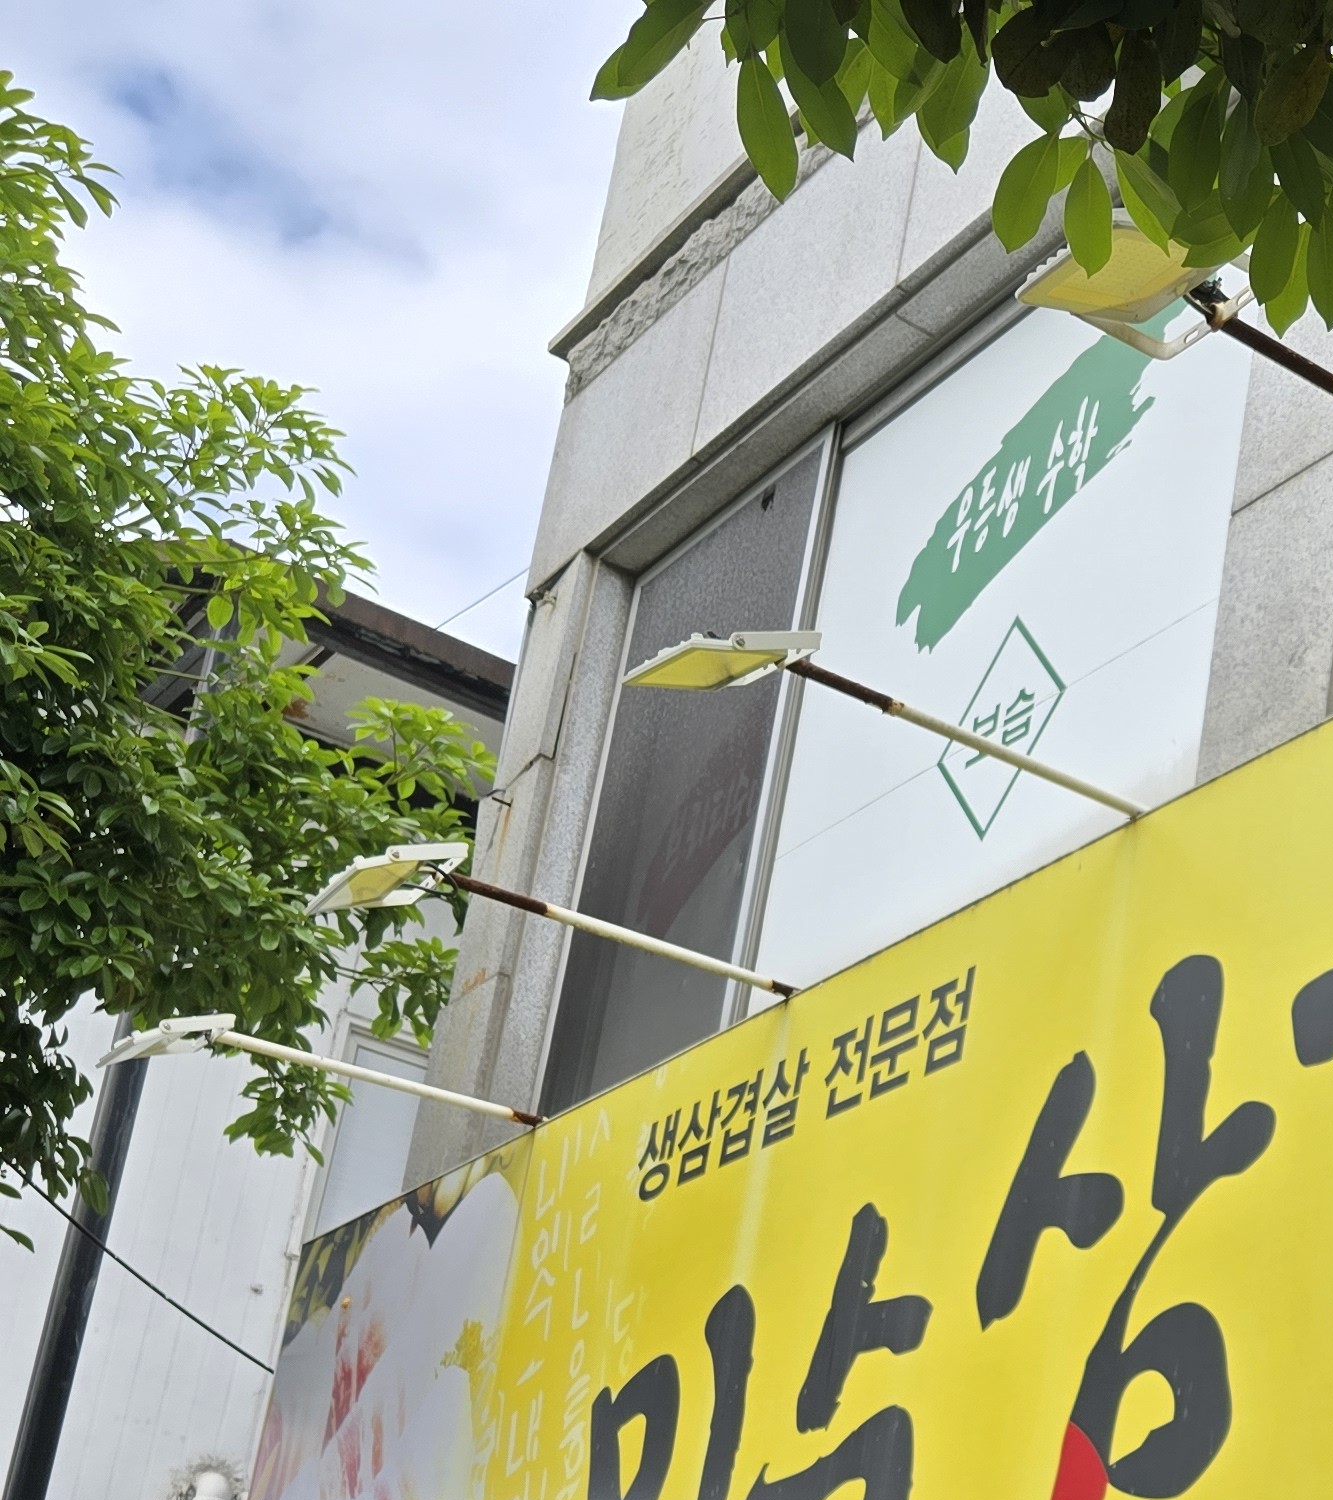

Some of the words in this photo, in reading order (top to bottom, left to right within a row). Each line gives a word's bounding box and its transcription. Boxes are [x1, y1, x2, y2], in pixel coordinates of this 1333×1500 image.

[946, 456, 1031, 573] 우등생
[1036, 396, 1100, 517] 수학
[964, 686, 1036, 770] 보습
[637, 1047, 809, 1203] 생삼겹살
[824, 965, 977, 1121] 전문점
